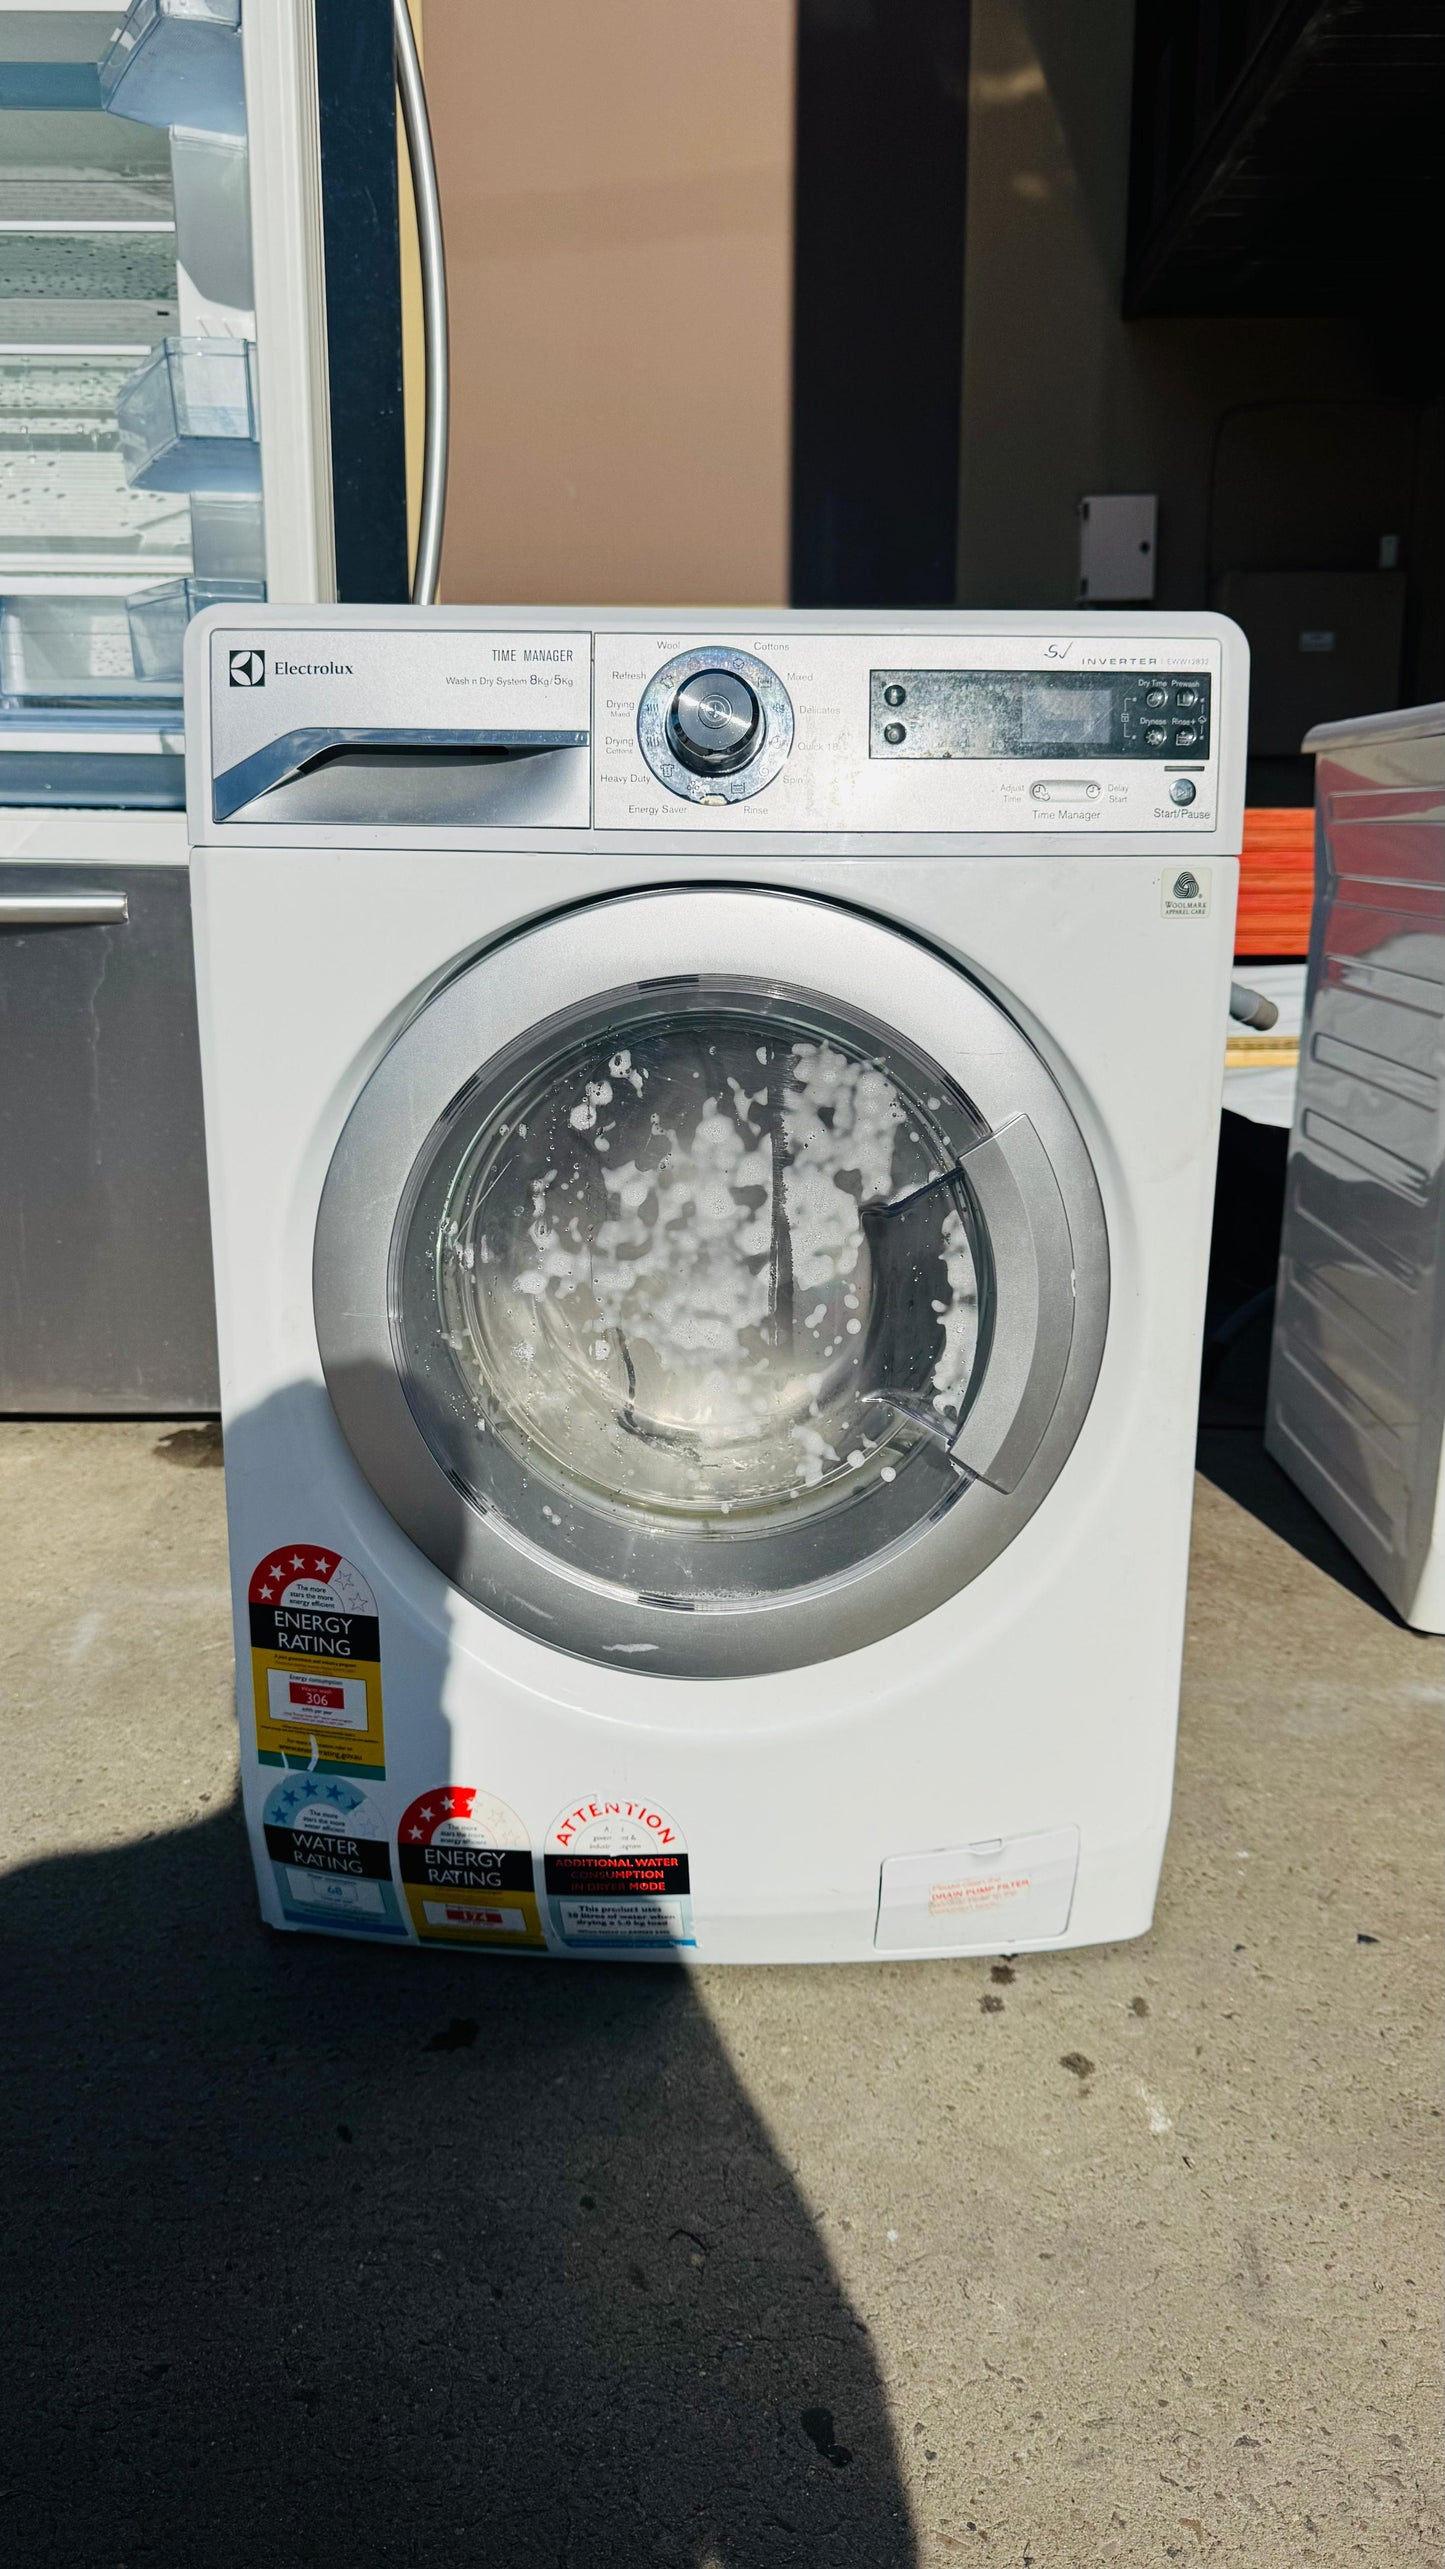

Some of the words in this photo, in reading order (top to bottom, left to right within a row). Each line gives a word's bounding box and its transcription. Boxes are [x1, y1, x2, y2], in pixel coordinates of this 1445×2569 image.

[657, 640, 680, 650] Wool
[753, 641, 789, 651] Cottons
[491, 649, 517, 662] TIME
[523, 649, 573, 662] MANAGER
[1081, 658, 1158, 666] INVERTER
[274, 661, 353, 676] Electrolux
[612, 671, 647, 680] Refresh
[787, 672, 813, 682] Mixed
[445, 676, 469, 686] Wash
[479, 676, 494, 688] Dry
[496, 676, 527, 688] System
[1138, 679, 1150, 688] Dry
[1151, 679, 1167, 687] Time
[1171, 679, 1200, 688] Prewash
[606, 700, 635, 710] Drying
[799, 705, 841, 715] Delicates
[1140, 717, 1167, 727] Dryness
[1171, 717, 1196, 726] Rinse+
[605, 736, 634, 747] Drying
[797, 742, 824, 752] Quick
[600, 774, 628, 784] Heavy
[630, 774, 651, 784] Duty
[783, 775, 803, 785] Spin
[1000, 783, 1025, 793] Adjust
[1108, 784, 1128, 794] Delay
[1109, 795, 1127, 803] Start
[628, 804, 659, 815] Energy
[662, 805, 687, 814] Saver
[743, 805, 769, 815] Rinse
[1153, 808, 1210, 820] Start/Pause
[1032, 810, 1055, 820] Time
[1058, 810, 1101, 821] Manager
[1165, 901, 1207, 909] WOOLMARK
[297, 1583, 308, 1592] The
[309, 1586, 326, 1594] more
[290, 1591, 305, 1601] stars
[306, 1593, 317, 1602] the
[289, 1599, 310, 1608] energy
[311, 1601, 335, 1609] efficient
[274, 1610, 353, 1635] ENERGY
[278, 1632, 351, 1656] RATING
[289, 1674, 308, 1683] Energy
[308, 1677, 343, 1686] consumption
[306, 1692, 328, 1706] 306
[556, 1801, 676, 1847] ATTENTION
[292, 1833, 360, 1857] WATER
[293, 1850, 363, 1874] RATING
[425, 1849, 506, 1868] ENERGY
[555, 1858, 633, 1867] ADDITIONAL
[634, 1858, 678, 1867] WATER
[428, 1869, 502, 1887] RATING
[570, 1870, 665, 1879] CONSUMPTION
[571, 1882, 584, 1891] IN
[587, 1882, 626, 1891] DRYER
[629, 1881, 666, 1891] MODE
[965, 1885, 994, 1895] PUMP
[996, 1879, 1030, 1891] FILTER
[578, 1905, 599, 1913] This
[601, 1906, 639, 1914] product
